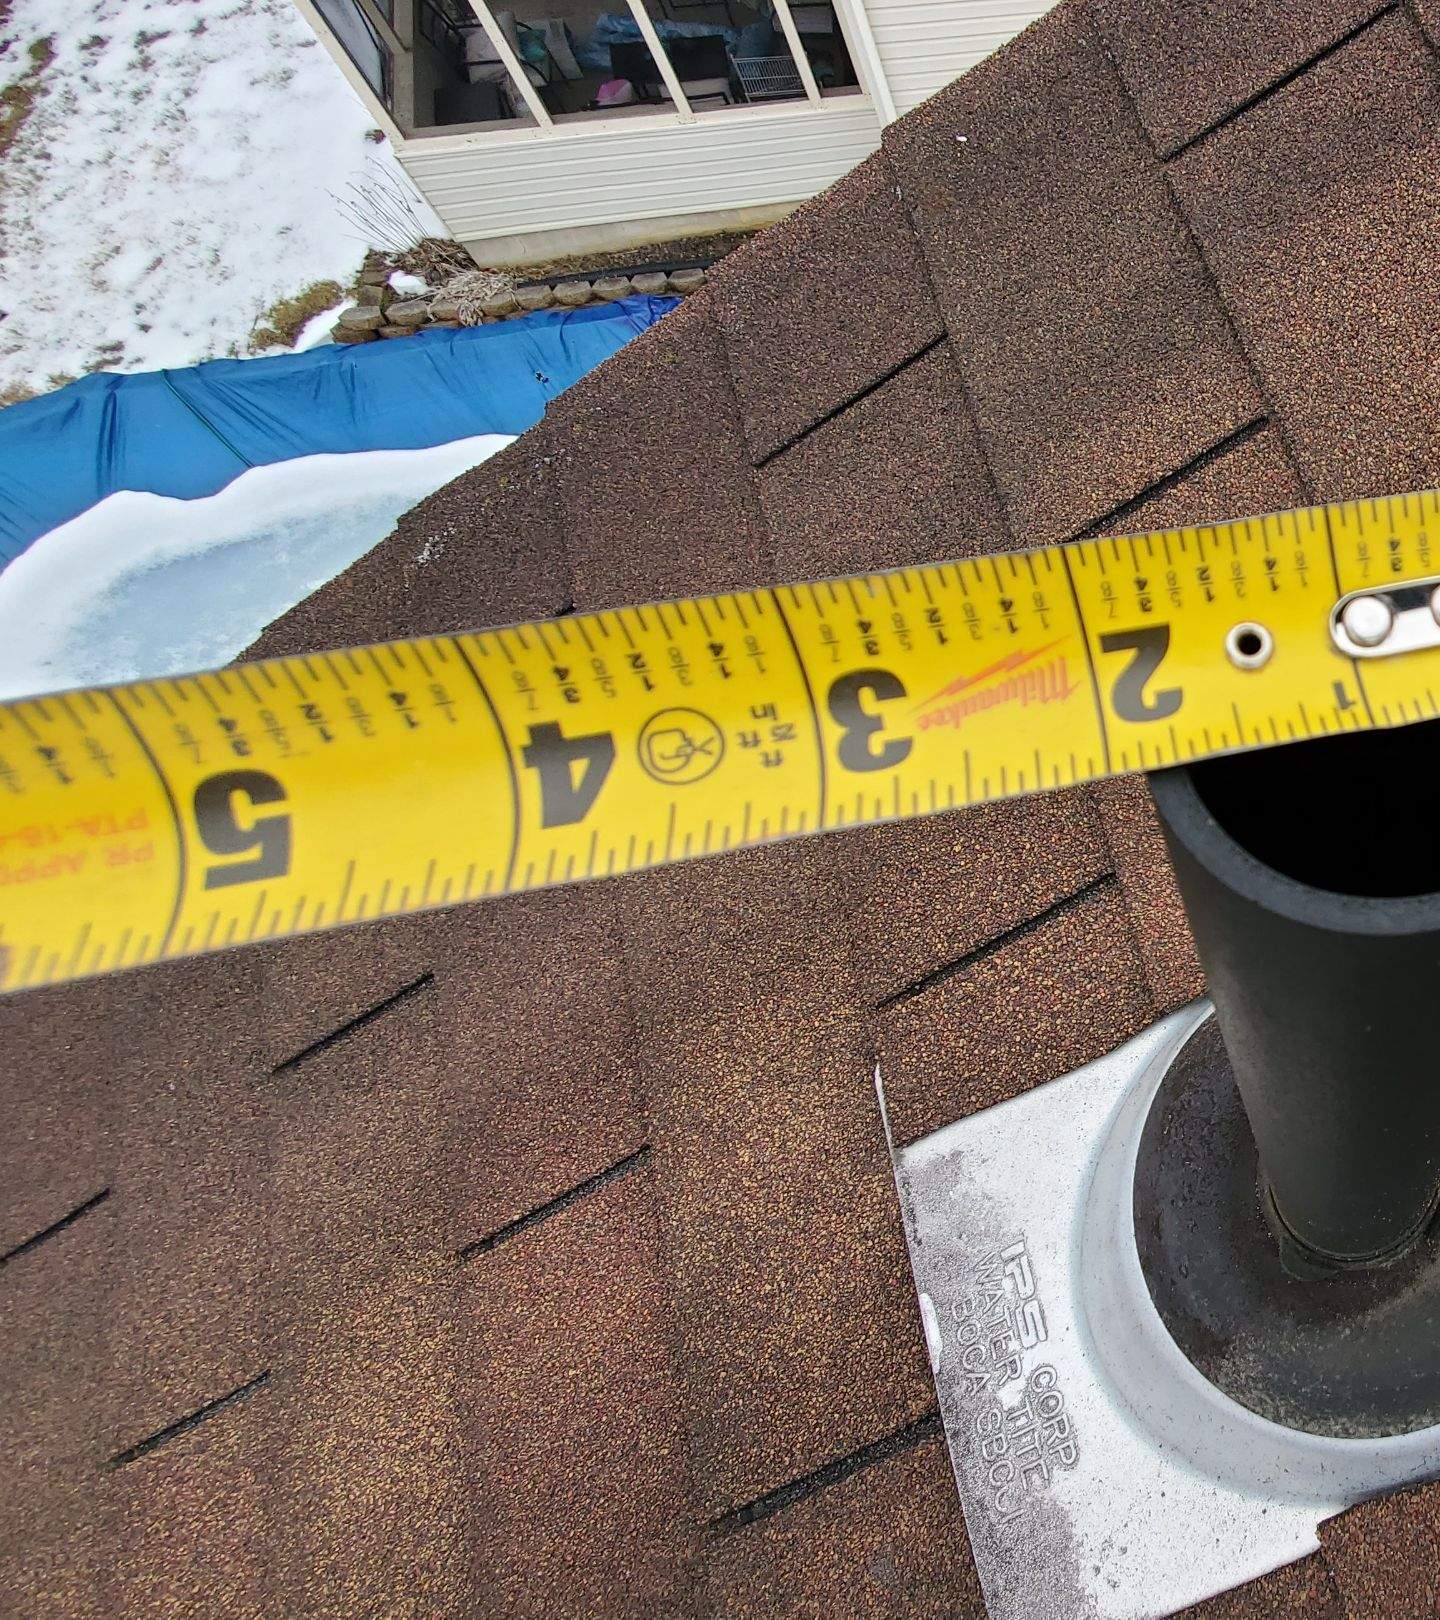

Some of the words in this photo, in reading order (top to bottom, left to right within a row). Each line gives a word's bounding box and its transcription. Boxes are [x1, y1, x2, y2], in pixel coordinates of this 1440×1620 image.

[749, 702, 777, 722] in
[827, 667, 914, 773] 3
[917, 654, 1082, 732] Milwaukee
[1099, 623, 1184, 724] 2
[1332, 680, 1357, 711] 1
[520, 720, 616, 830] 4
[193, 768, 293, 892] 5
[952, 1297, 993, 1396] BOCA
[974, 1250, 1023, 1387] WATER
[1003, 1395, 1050, 1491] TITE
[1000, 1238, 1049, 1348] IPS
[1030, 1364, 1080, 1468] CORP
